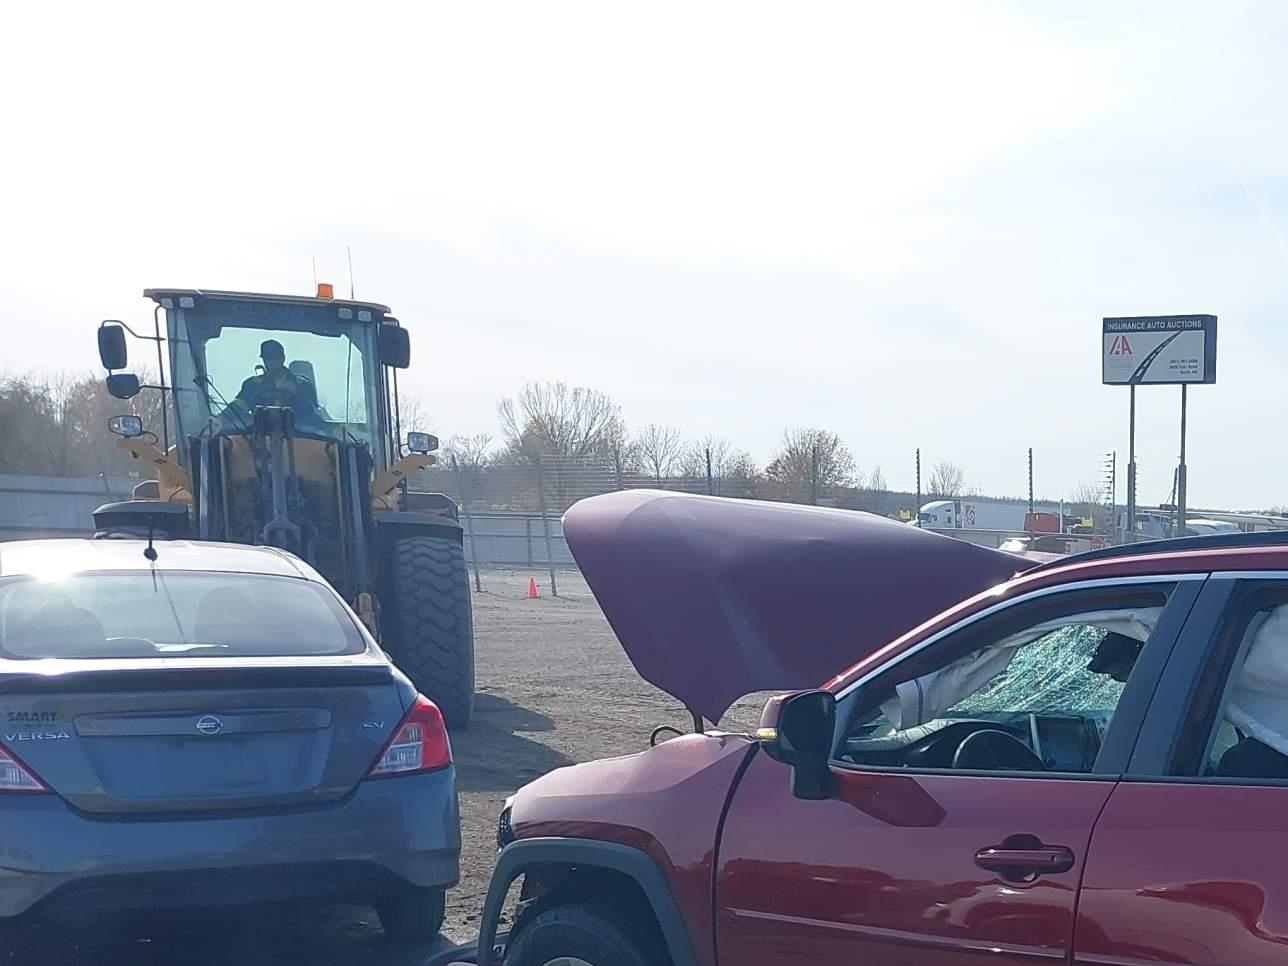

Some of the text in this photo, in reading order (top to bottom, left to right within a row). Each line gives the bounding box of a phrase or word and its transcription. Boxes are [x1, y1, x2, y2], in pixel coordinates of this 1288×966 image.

[1107, 319, 1202, 330] INSURANCE AUTO AUCTIONS
[8, 711, 57, 721] SMART
[4, 732, 71, 741] VERSA
